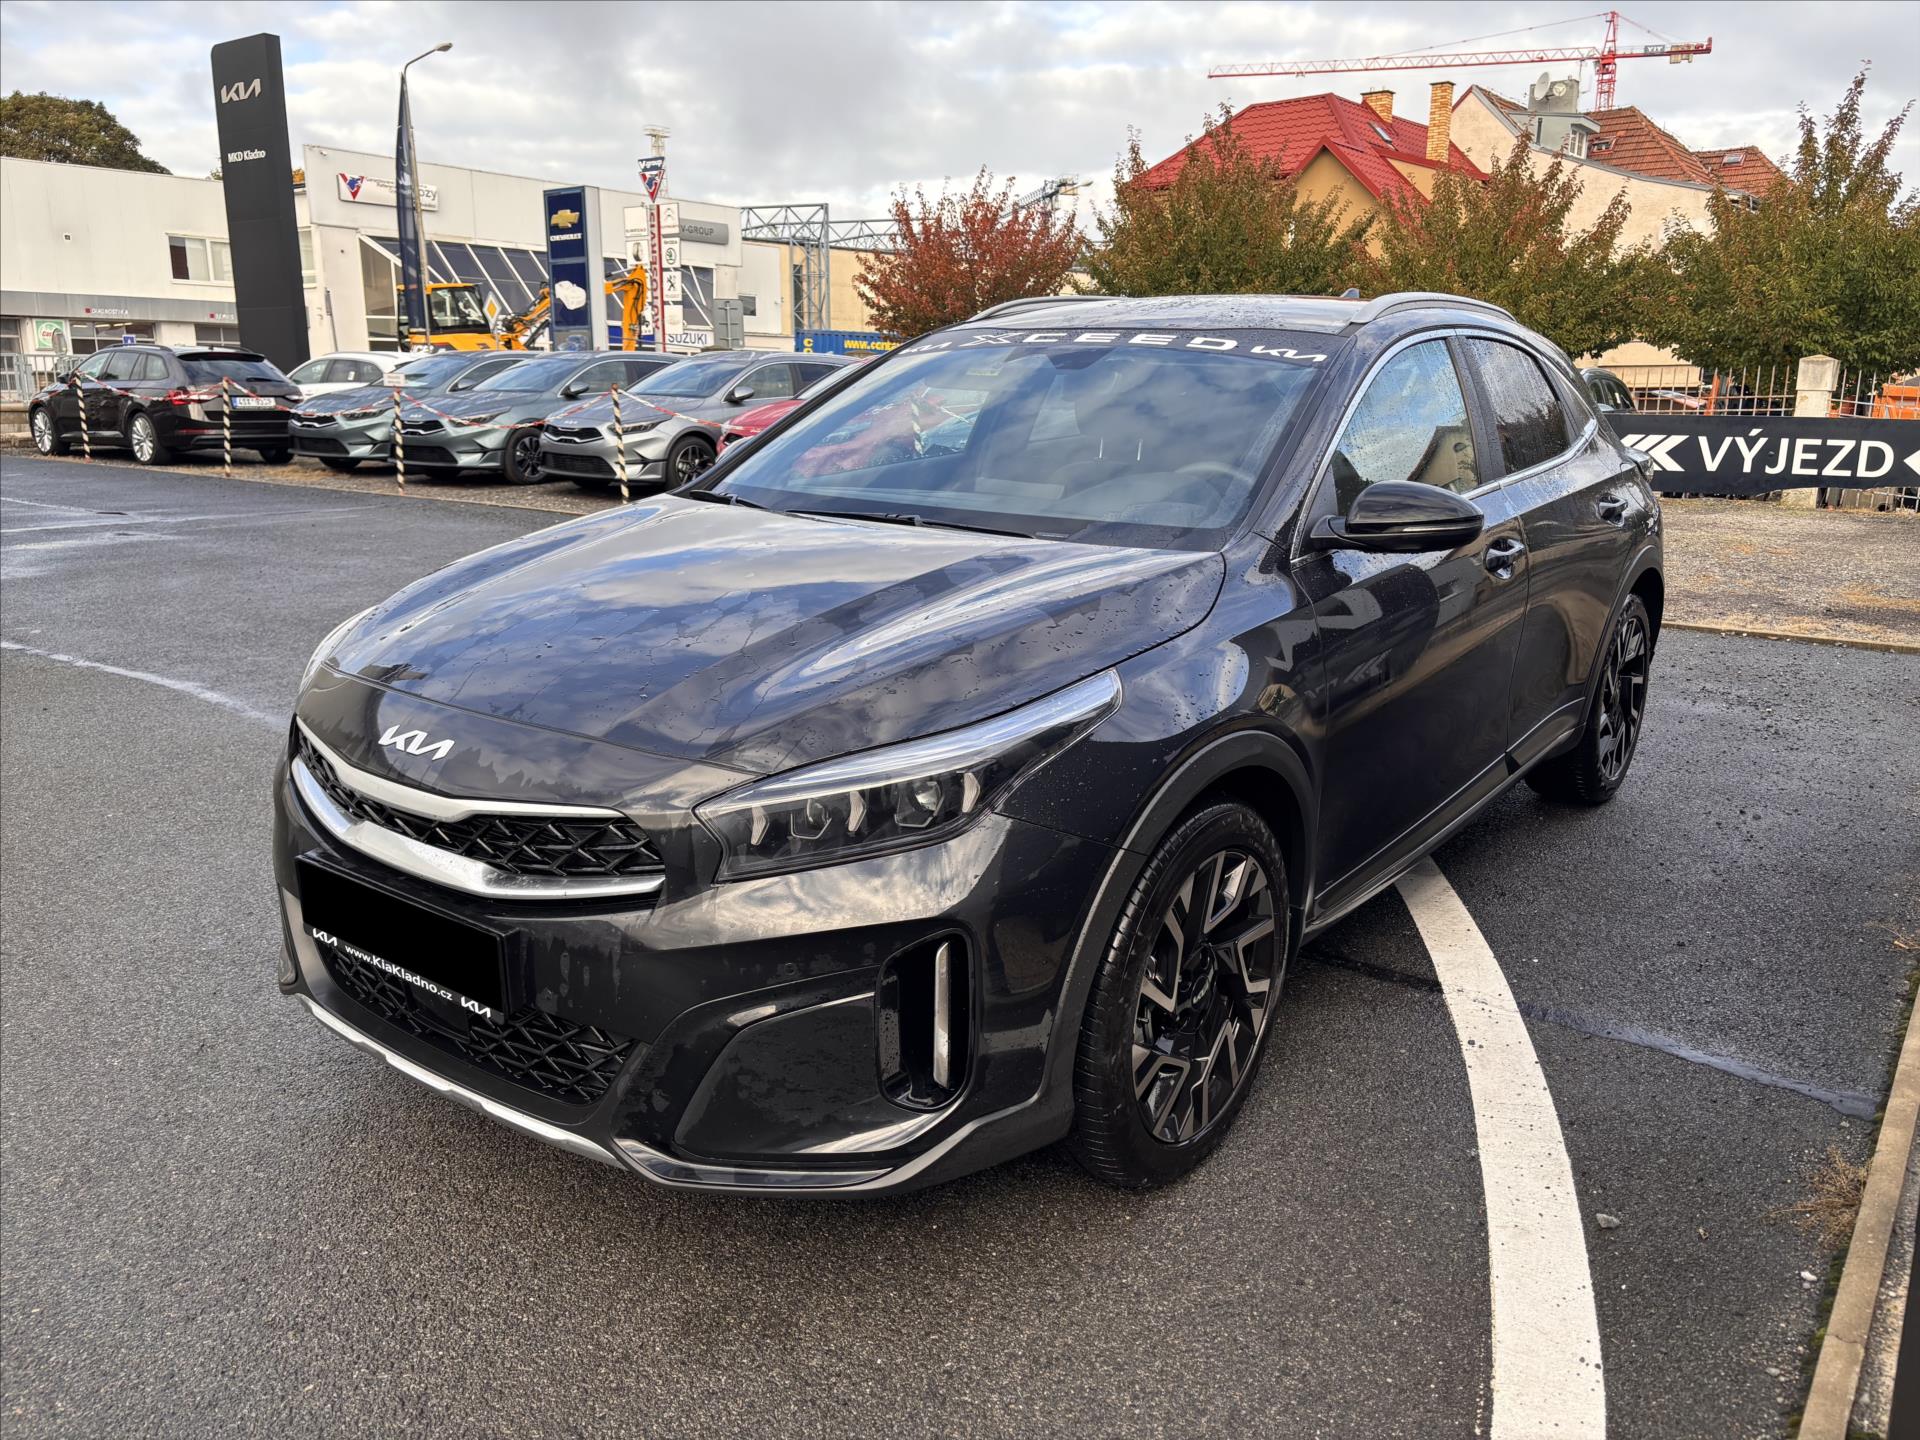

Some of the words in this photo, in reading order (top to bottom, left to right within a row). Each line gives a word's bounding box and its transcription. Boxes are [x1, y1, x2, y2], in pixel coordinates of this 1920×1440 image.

[221, 79, 261, 103] KIA
[228, 152, 243, 163] MKD
[243, 149, 266, 160] Kladno
[668, 332, 707, 345] SUZUKI
[959, 332, 1239, 351] XCEED
[1250, 345, 1328, 362] KIA
[1697, 428, 1895, 478] VÝJEZD
[378, 724, 455, 761] KIA
[312, 927, 338, 947] KIA
[344, 943, 453, 1001] www.KiaKladno.cz
[460, 995, 492, 1019] KIA
